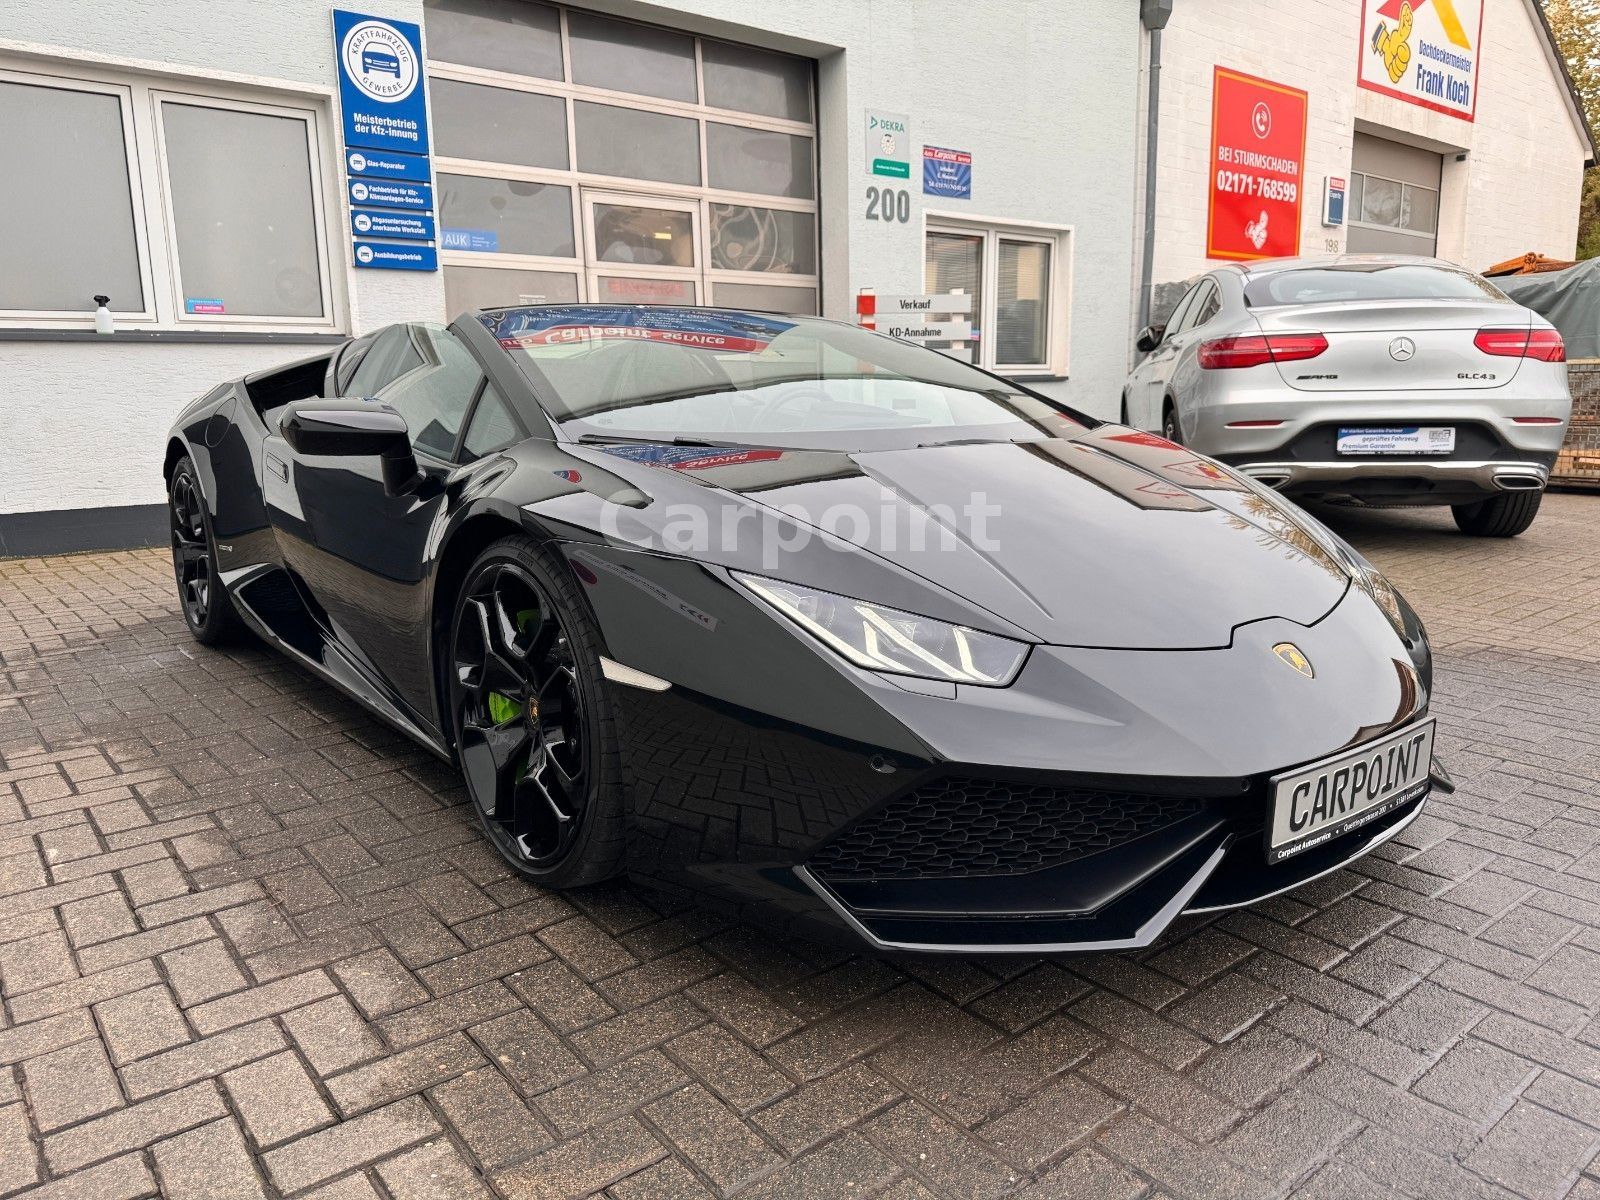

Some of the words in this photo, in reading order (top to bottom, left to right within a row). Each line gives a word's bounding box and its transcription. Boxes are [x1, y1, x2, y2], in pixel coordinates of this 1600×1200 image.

[352, 30, 409, 63] KRAFTFAHRZEUG
[1419, 39, 1472, 73] Dachdeckermeister
[362, 77, 403, 94] GEWERBE
[1416, 63, 1444, 98] Frank
[1446, 74, 1470, 106] Koch
[353, 112, 417, 130] Meisterbetrieb
[354, 123, 370, 133] der
[880, 119, 905, 133] DEKRA
[367, 160, 406, 170] Glas-Reparatur
[1218, 146, 1232, 162] BEI
[1234, 149, 1298, 175] STURMSCHADEN
[368, 185, 399, 195] Fachbetrieb
[399, 188, 408, 196] für
[1217, 170, 1297, 203] 02171-768599
[865, 186, 910, 224] 200
[371, 216, 422, 228] Abgasuntersuchung
[372, 224, 401, 233] anerkannte
[402, 226, 426, 235] Werkstatt
[1324, 238, 1339, 253] 198
[374, 251, 422, 261] Ausbildungsbetrieb
[900, 299, 931, 310] Verkauf
[889, 327, 942, 338] KD-Annahme
[1391, 435, 1419, 443] Fahrzeug
[1289, 732, 1426, 832] CARPOINT
[1277, 841, 1302, 859] Carpoint
[1300, 832, 1332, 850] Autoservice
